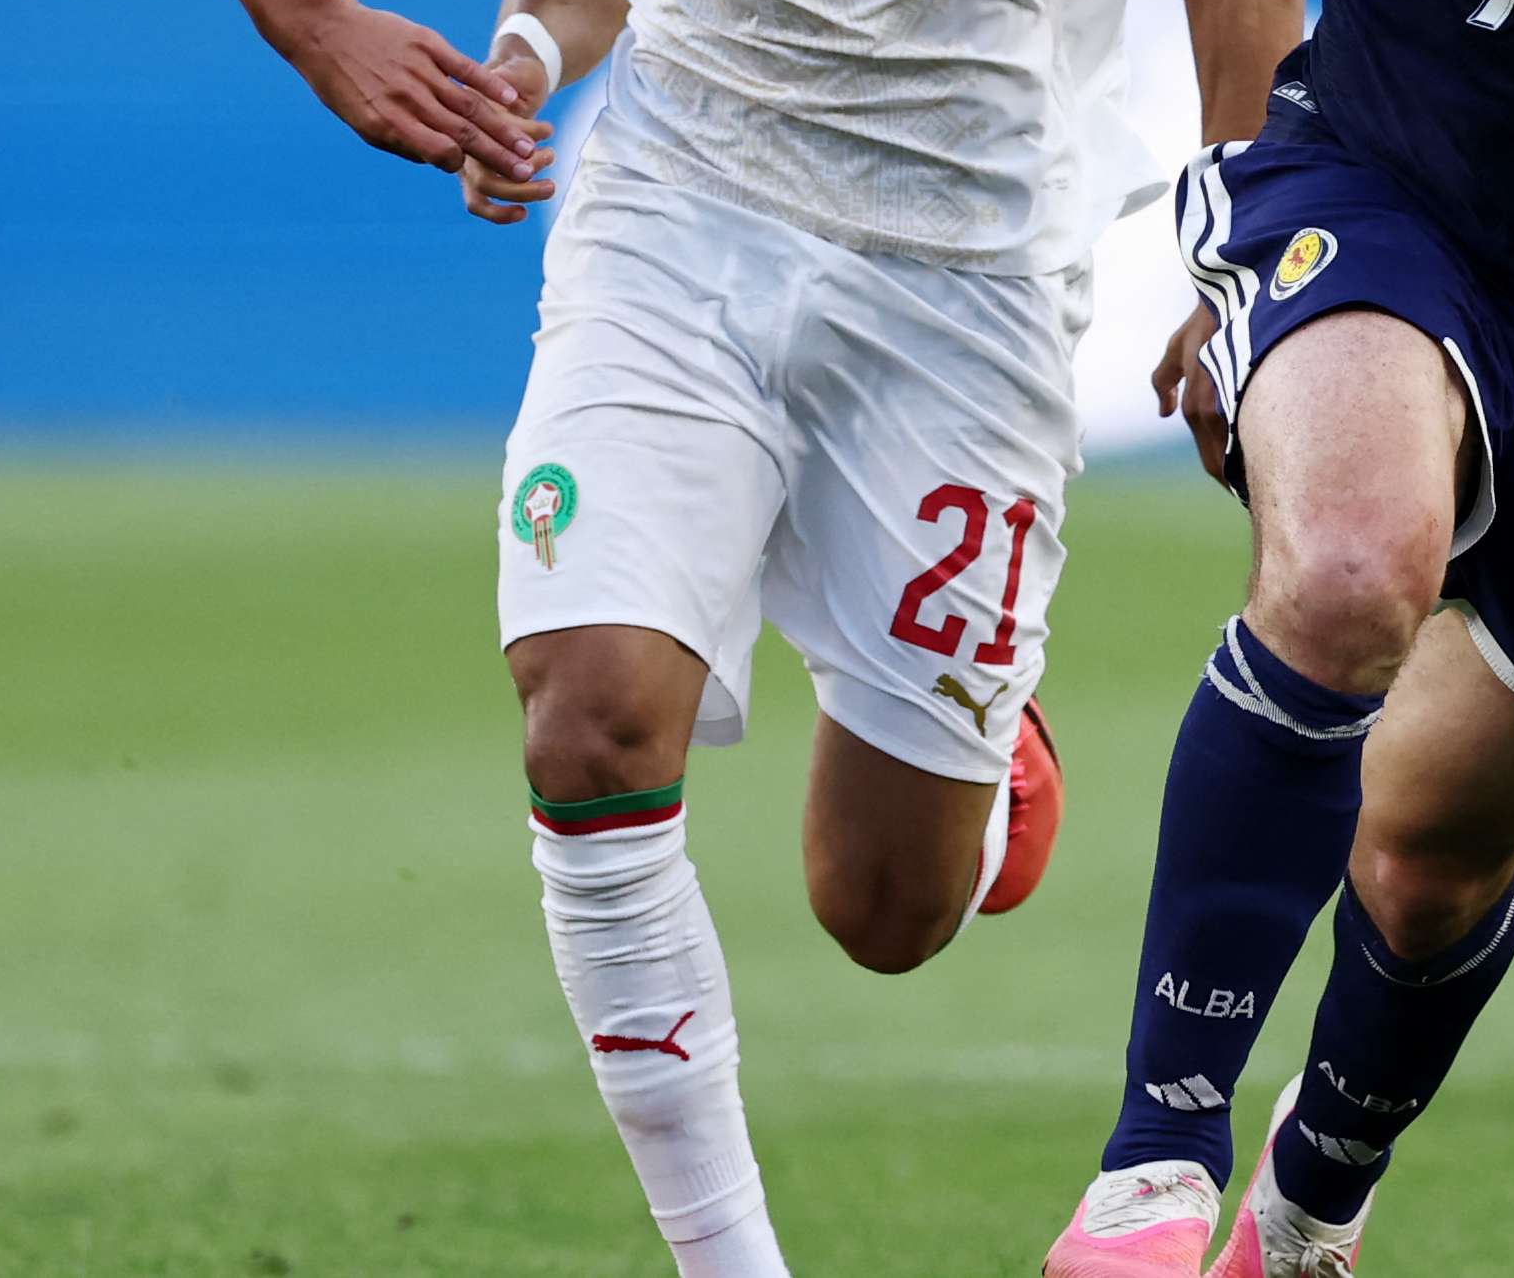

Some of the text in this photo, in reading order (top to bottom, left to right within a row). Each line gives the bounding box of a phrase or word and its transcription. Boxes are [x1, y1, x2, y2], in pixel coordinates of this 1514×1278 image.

[890, 483, 1036, 666] 21
[1154, 972, 1256, 1019] ALBA
[1318, 1060, 1418, 1113] ALBA
